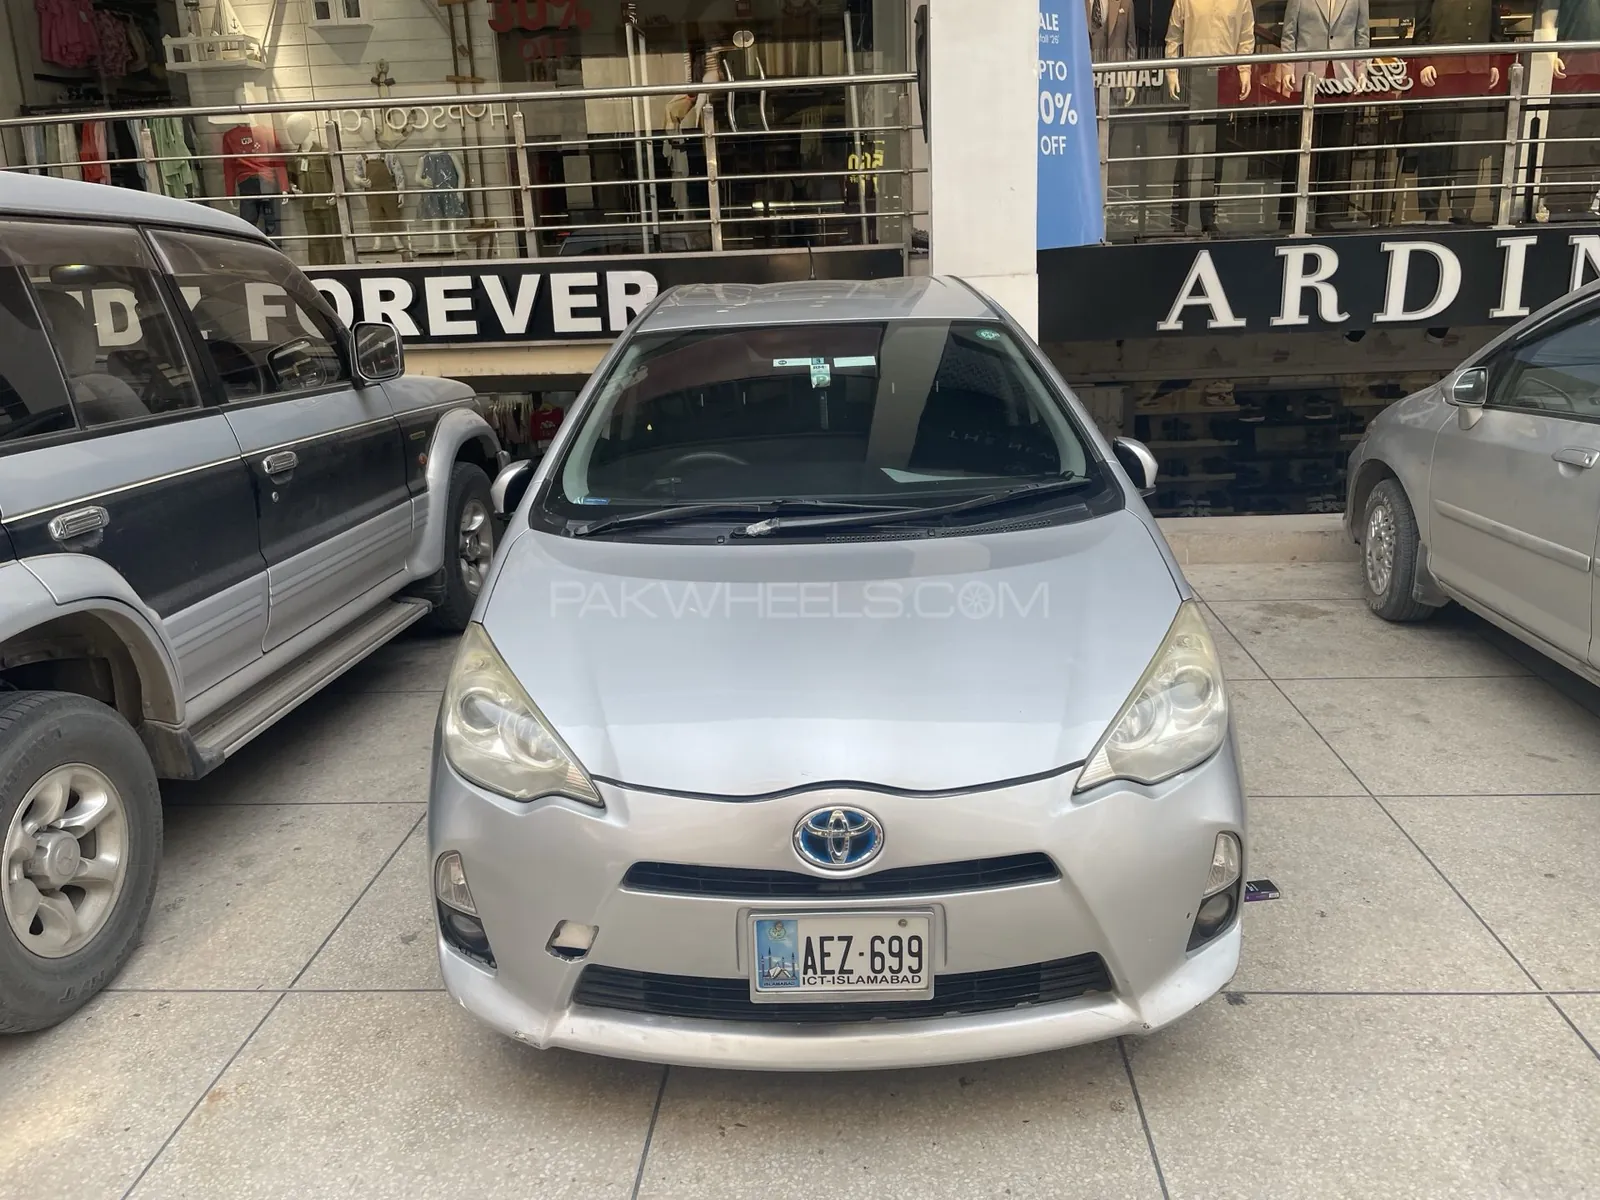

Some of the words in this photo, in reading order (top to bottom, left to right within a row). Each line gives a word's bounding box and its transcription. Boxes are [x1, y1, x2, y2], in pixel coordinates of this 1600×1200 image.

[1039, 12, 1060, 31] ALE
[1039, 60, 1067, 81] PTO
[1039, 91, 1078, 125] 0%
[1040, 135, 1067, 155] OFF
[245, 270, 659, 341] FOREVER
[802, 975, 921, 985] ICT-ISLAMABAD
